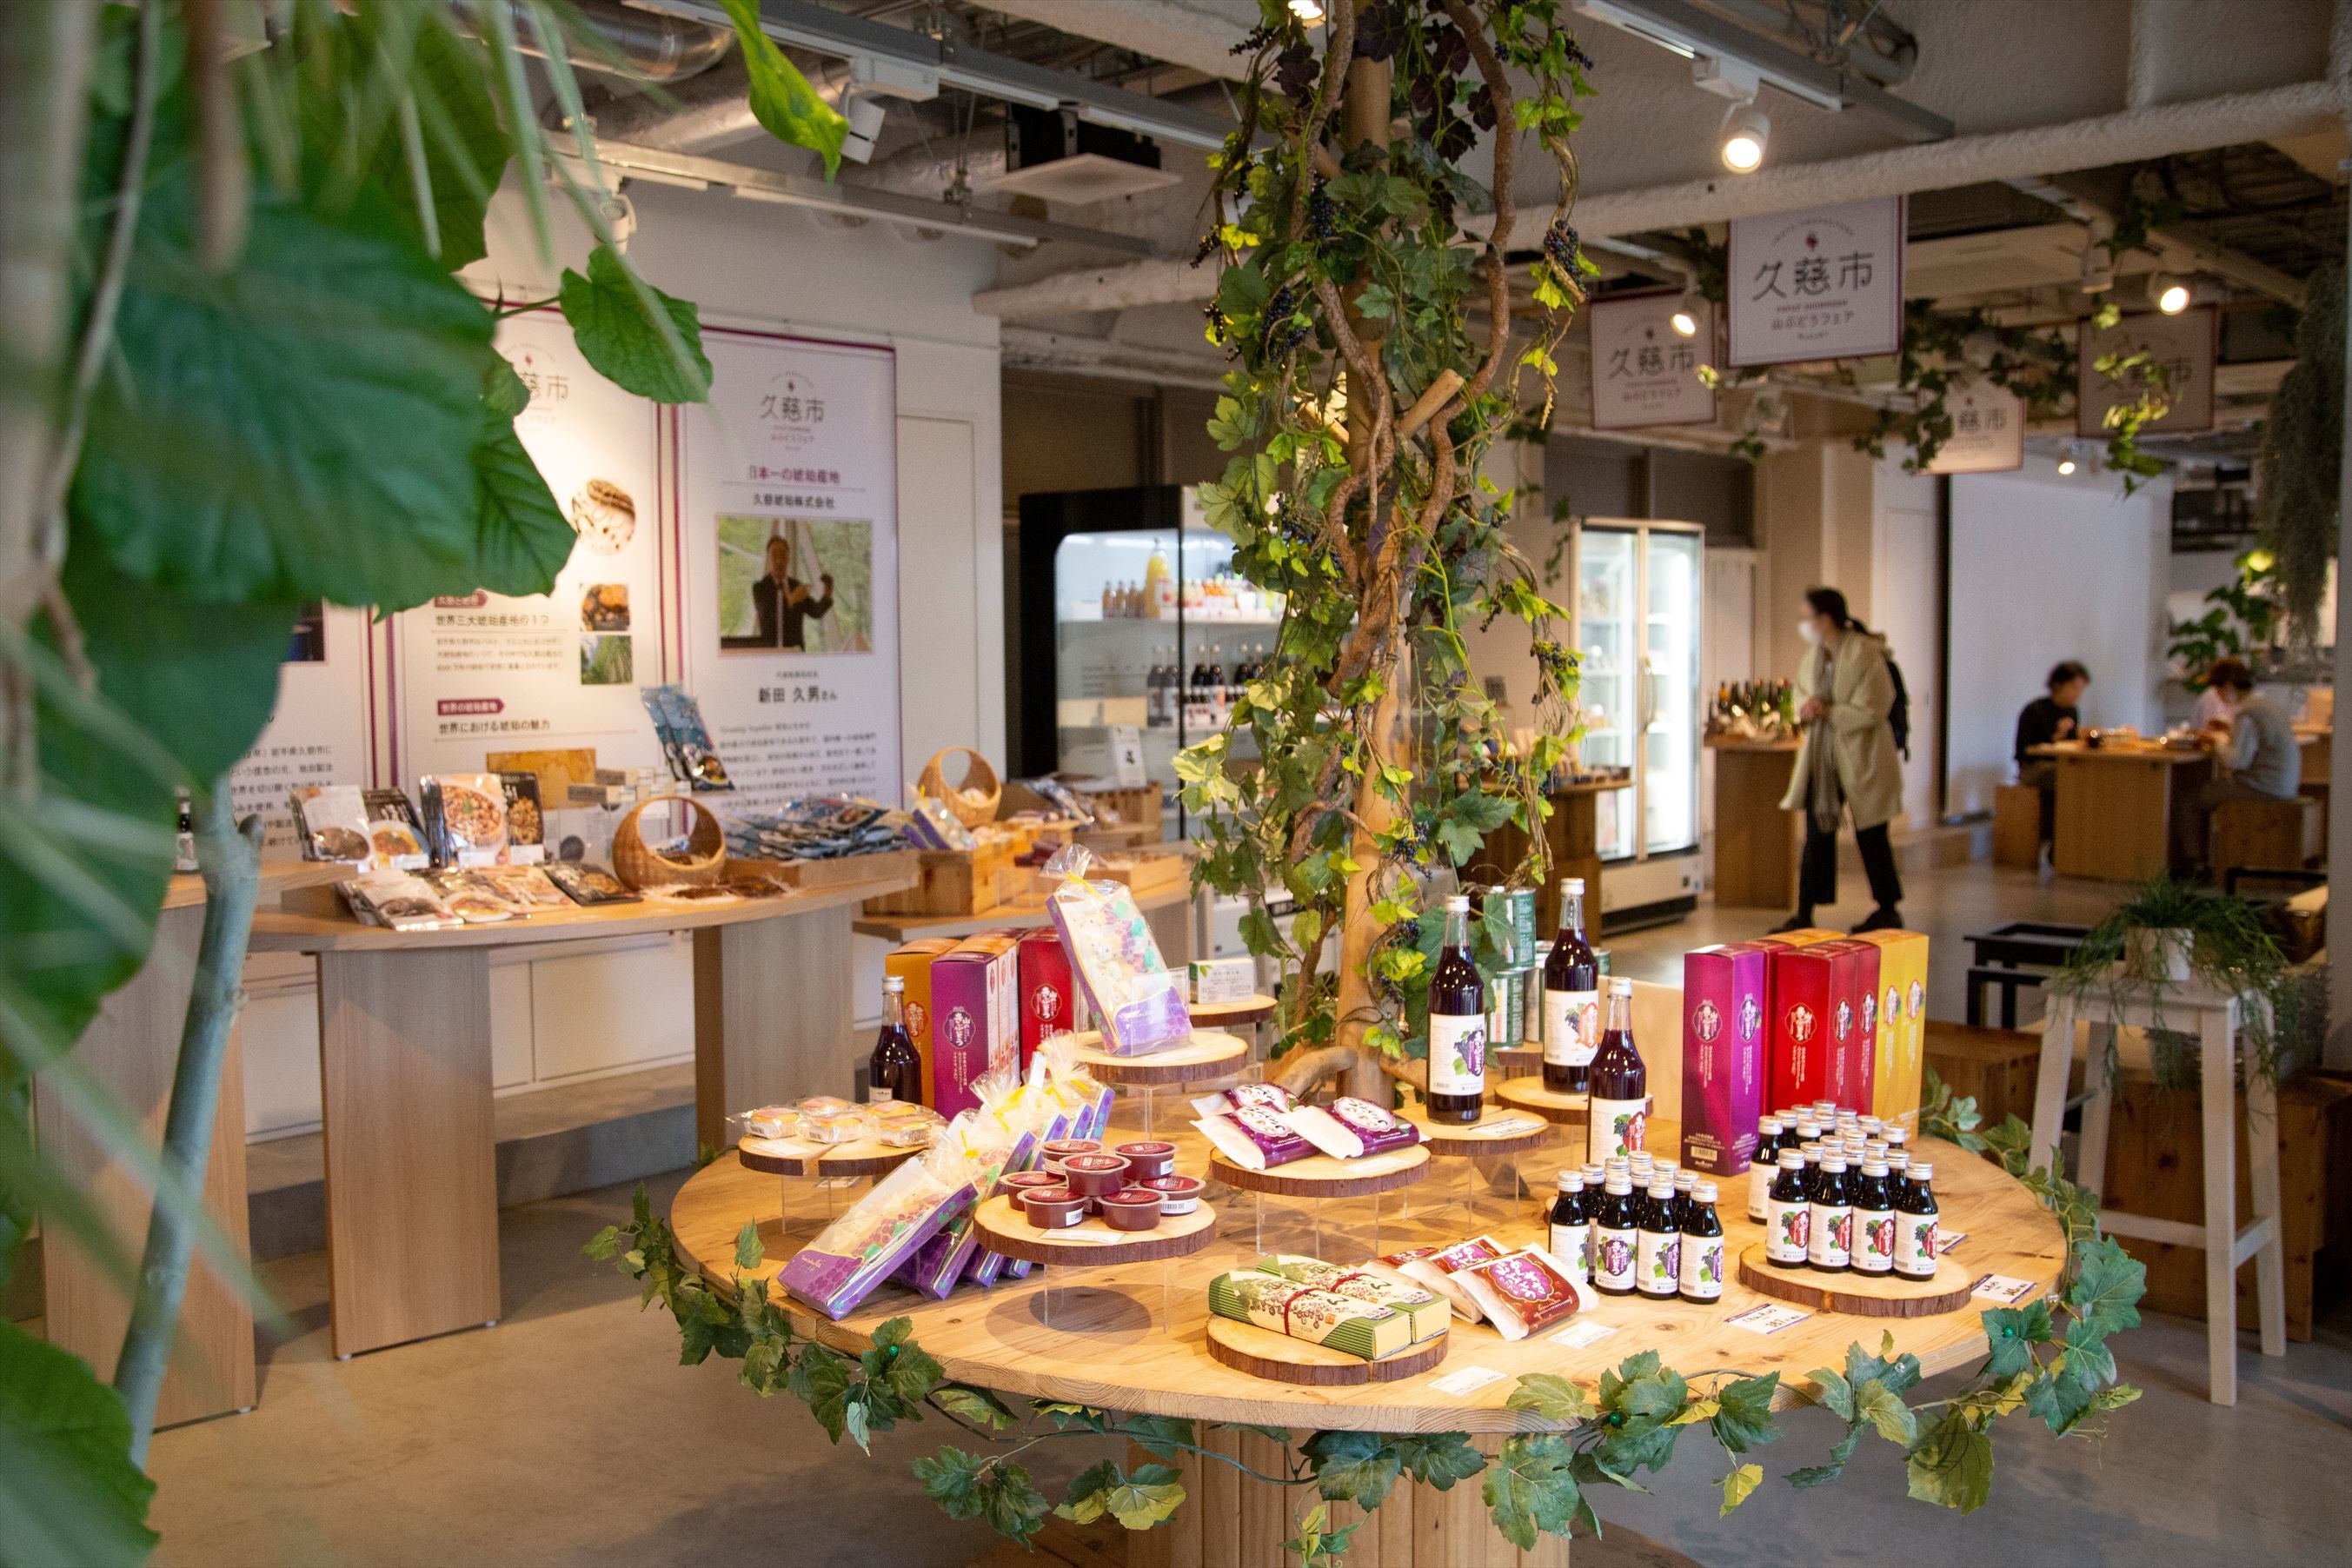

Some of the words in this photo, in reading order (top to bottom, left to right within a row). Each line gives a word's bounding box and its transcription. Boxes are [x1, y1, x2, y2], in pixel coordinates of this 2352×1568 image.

[1752, 250, 1874, 302] 久慈市
[1608, 342, 1695, 381] 久慈市
[760, 394, 825, 423] 久慈市
